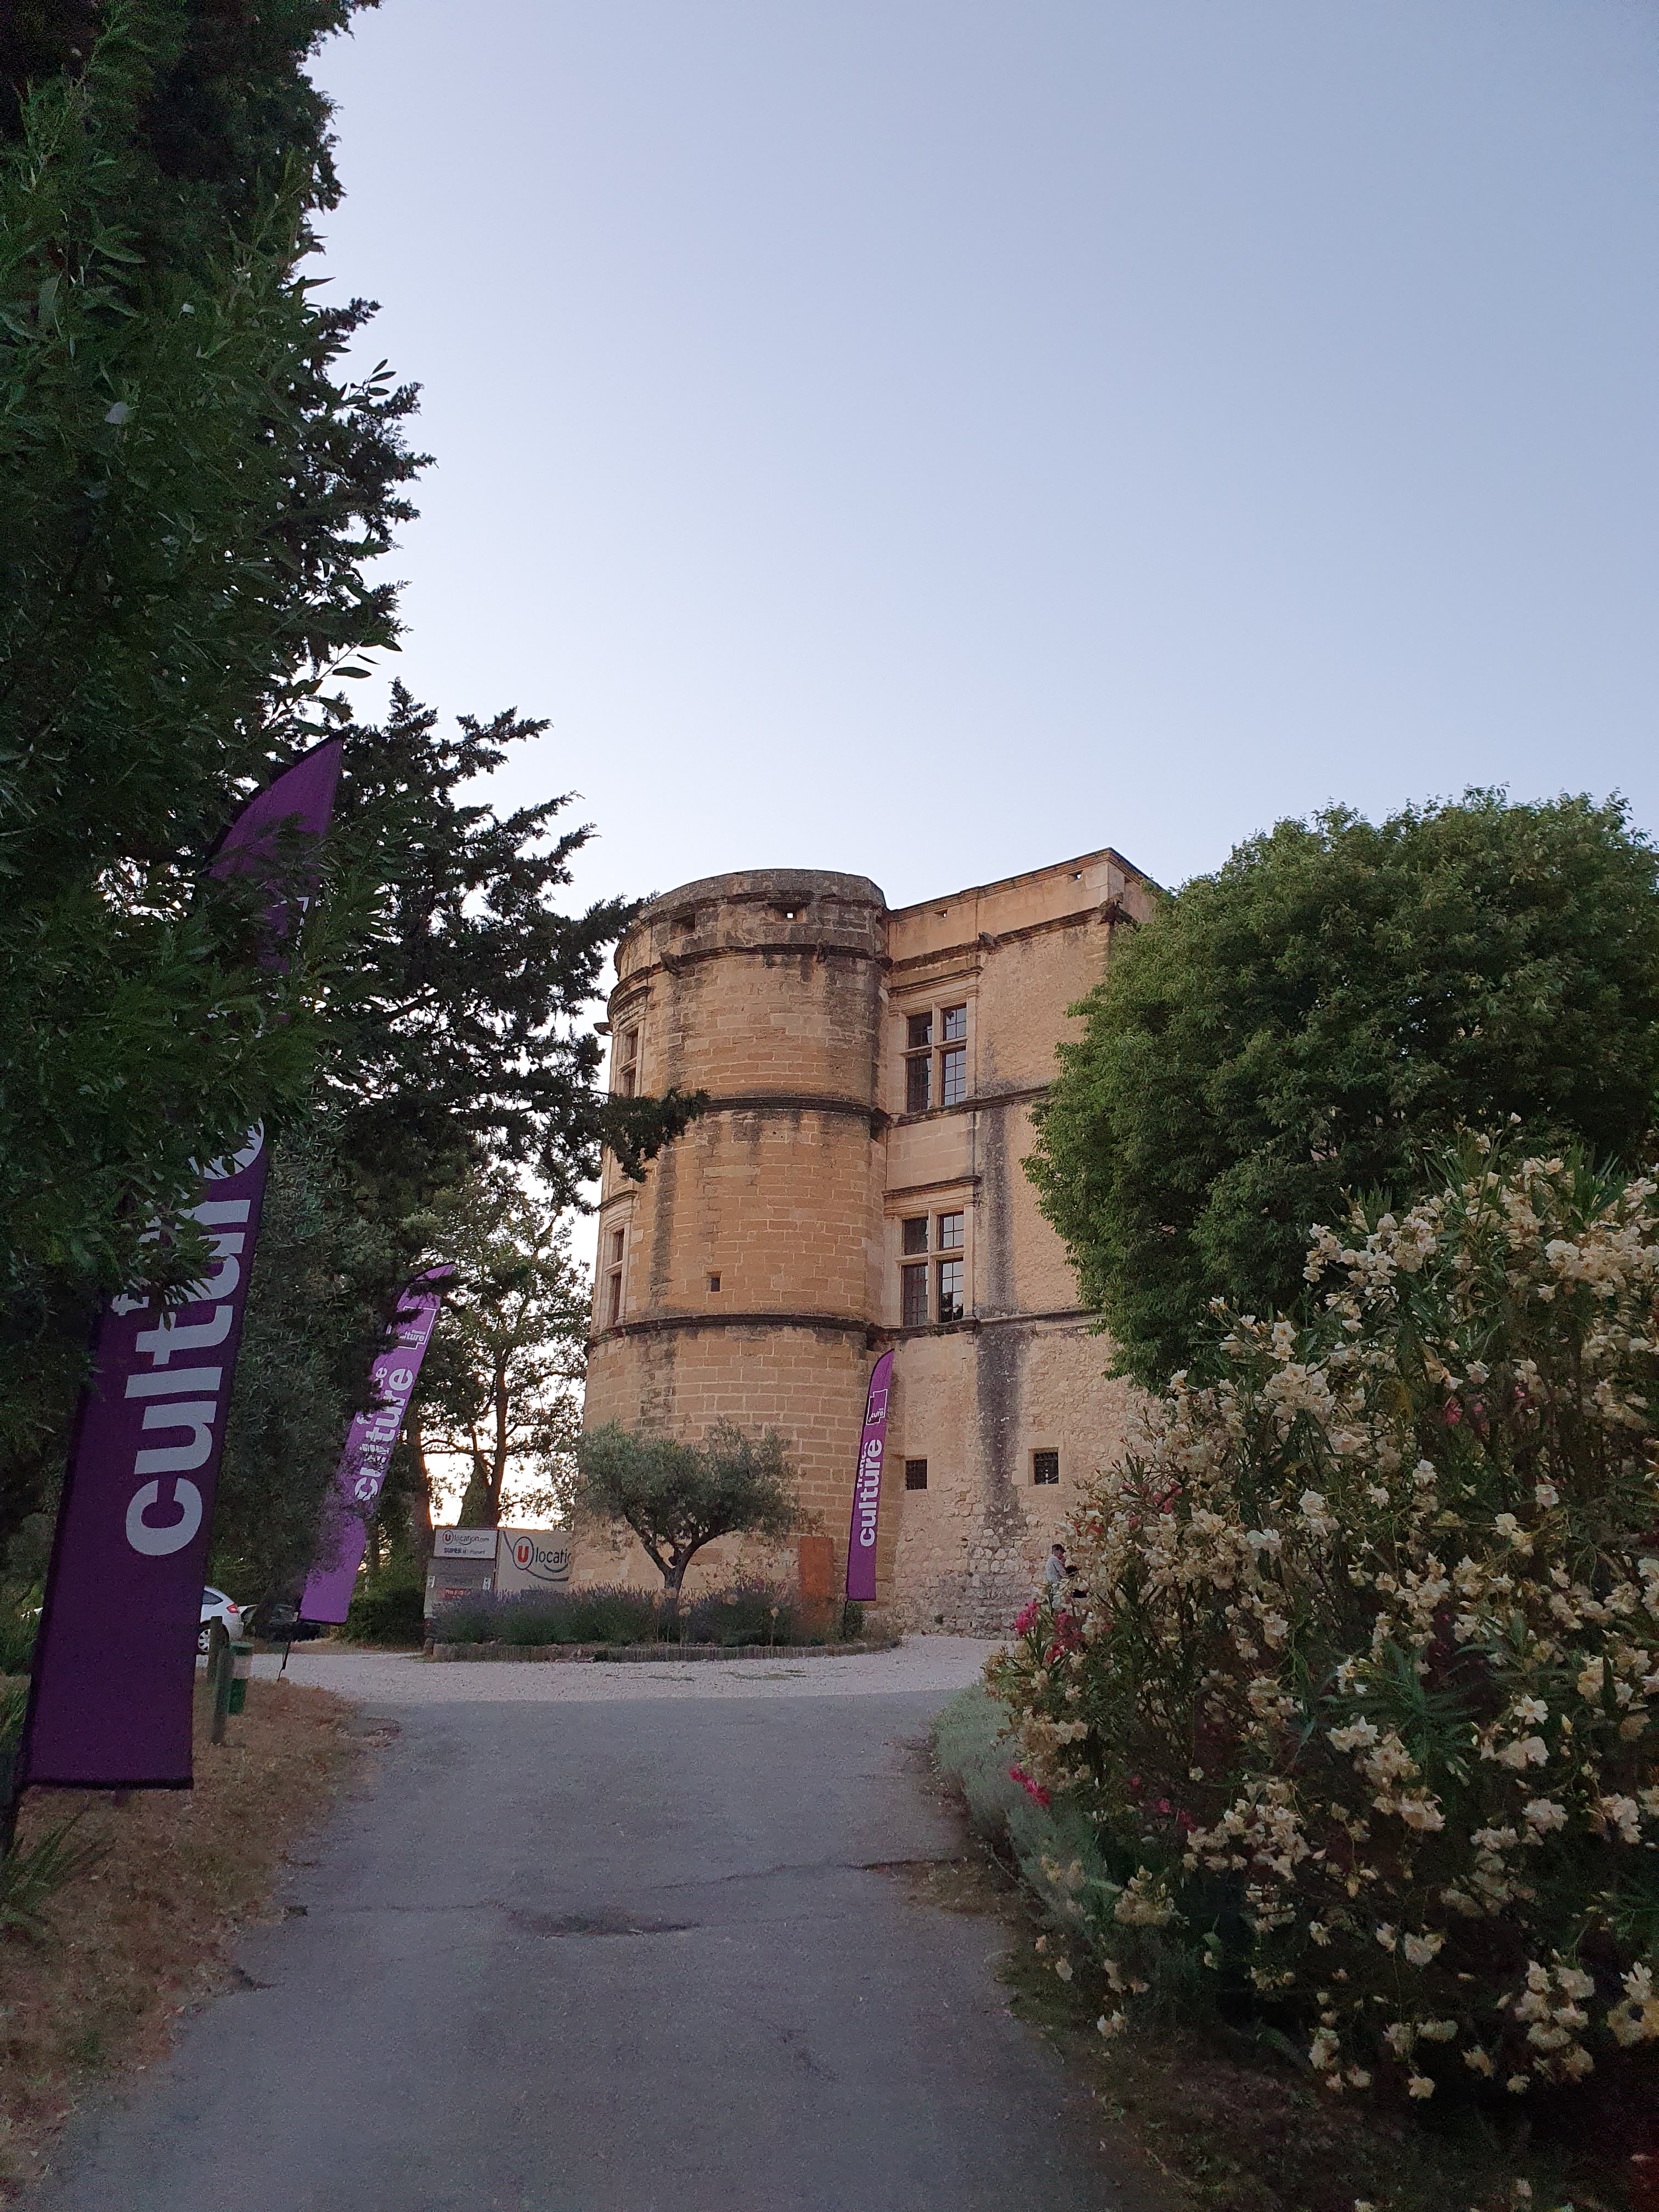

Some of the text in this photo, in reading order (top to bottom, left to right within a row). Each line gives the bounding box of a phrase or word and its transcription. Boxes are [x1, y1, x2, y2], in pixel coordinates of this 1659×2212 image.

[399, 1331, 425, 1341] lture
[354, 1368, 414, 1502] culture
[857, 1439, 882, 1547] culture
[517, 1545, 529, 1563] U
